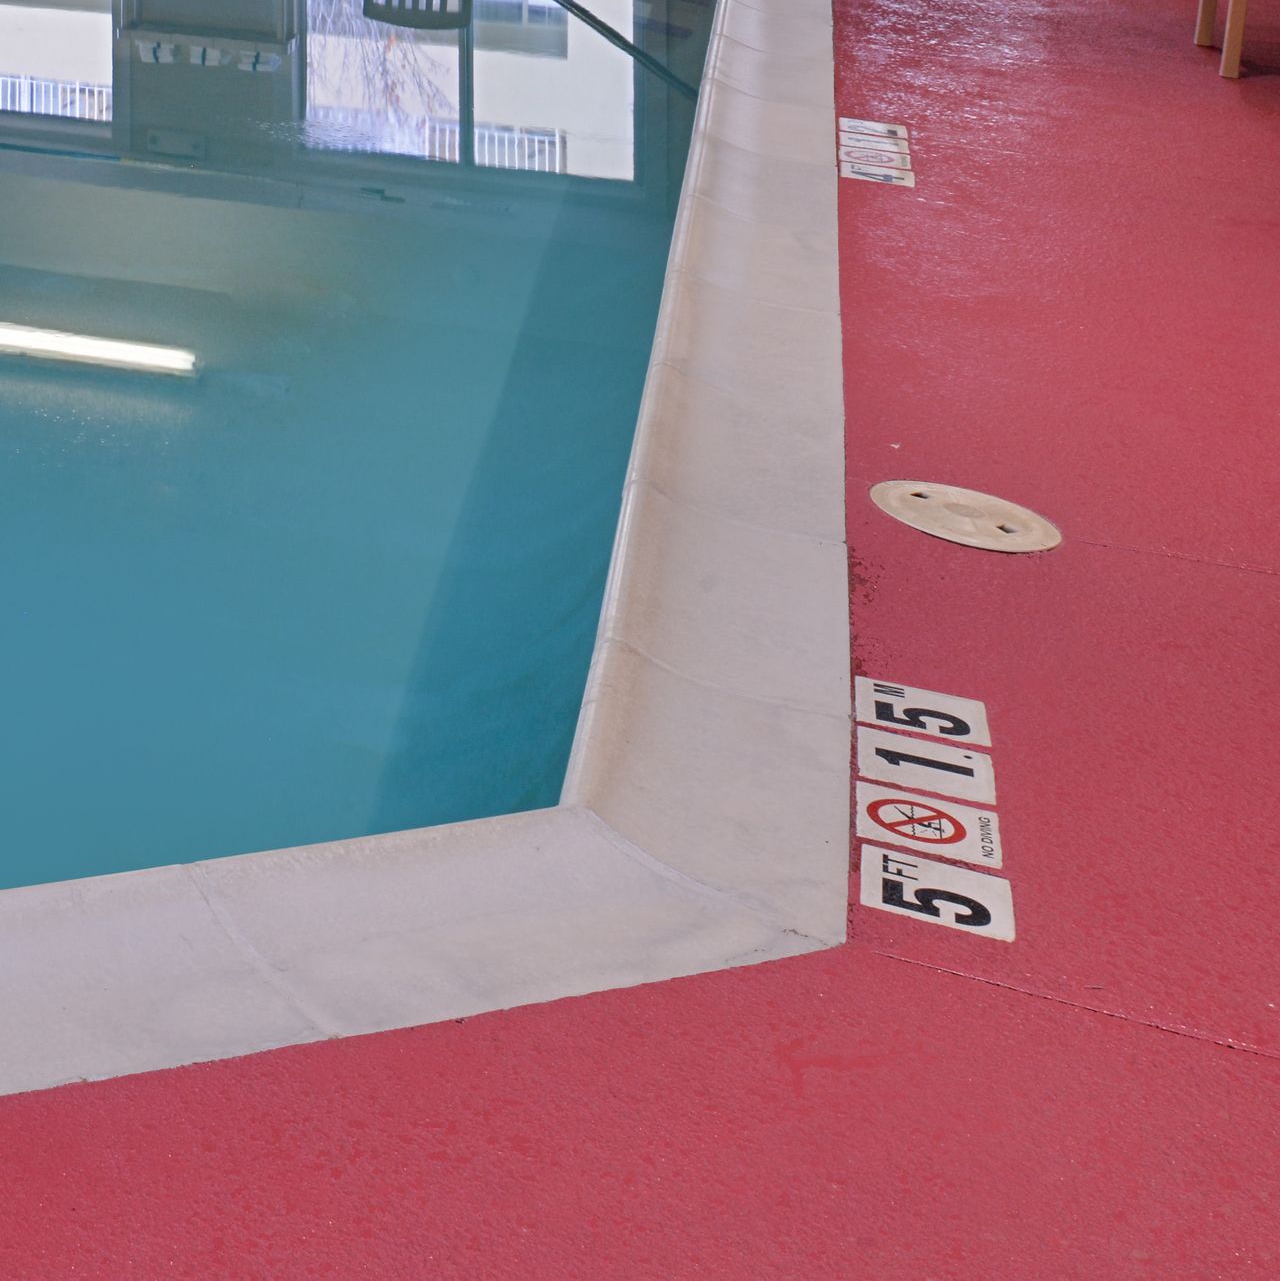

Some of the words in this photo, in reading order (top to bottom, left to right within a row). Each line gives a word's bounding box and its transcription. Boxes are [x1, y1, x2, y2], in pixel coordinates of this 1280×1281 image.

[872, 682, 906, 698] M
[874, 700, 971, 737] 5
[977, 816, 992, 846] DIVING
[982, 845, 995, 859] NO
[882, 854, 919, 881] FT
[881, 876, 992, 927] 5
